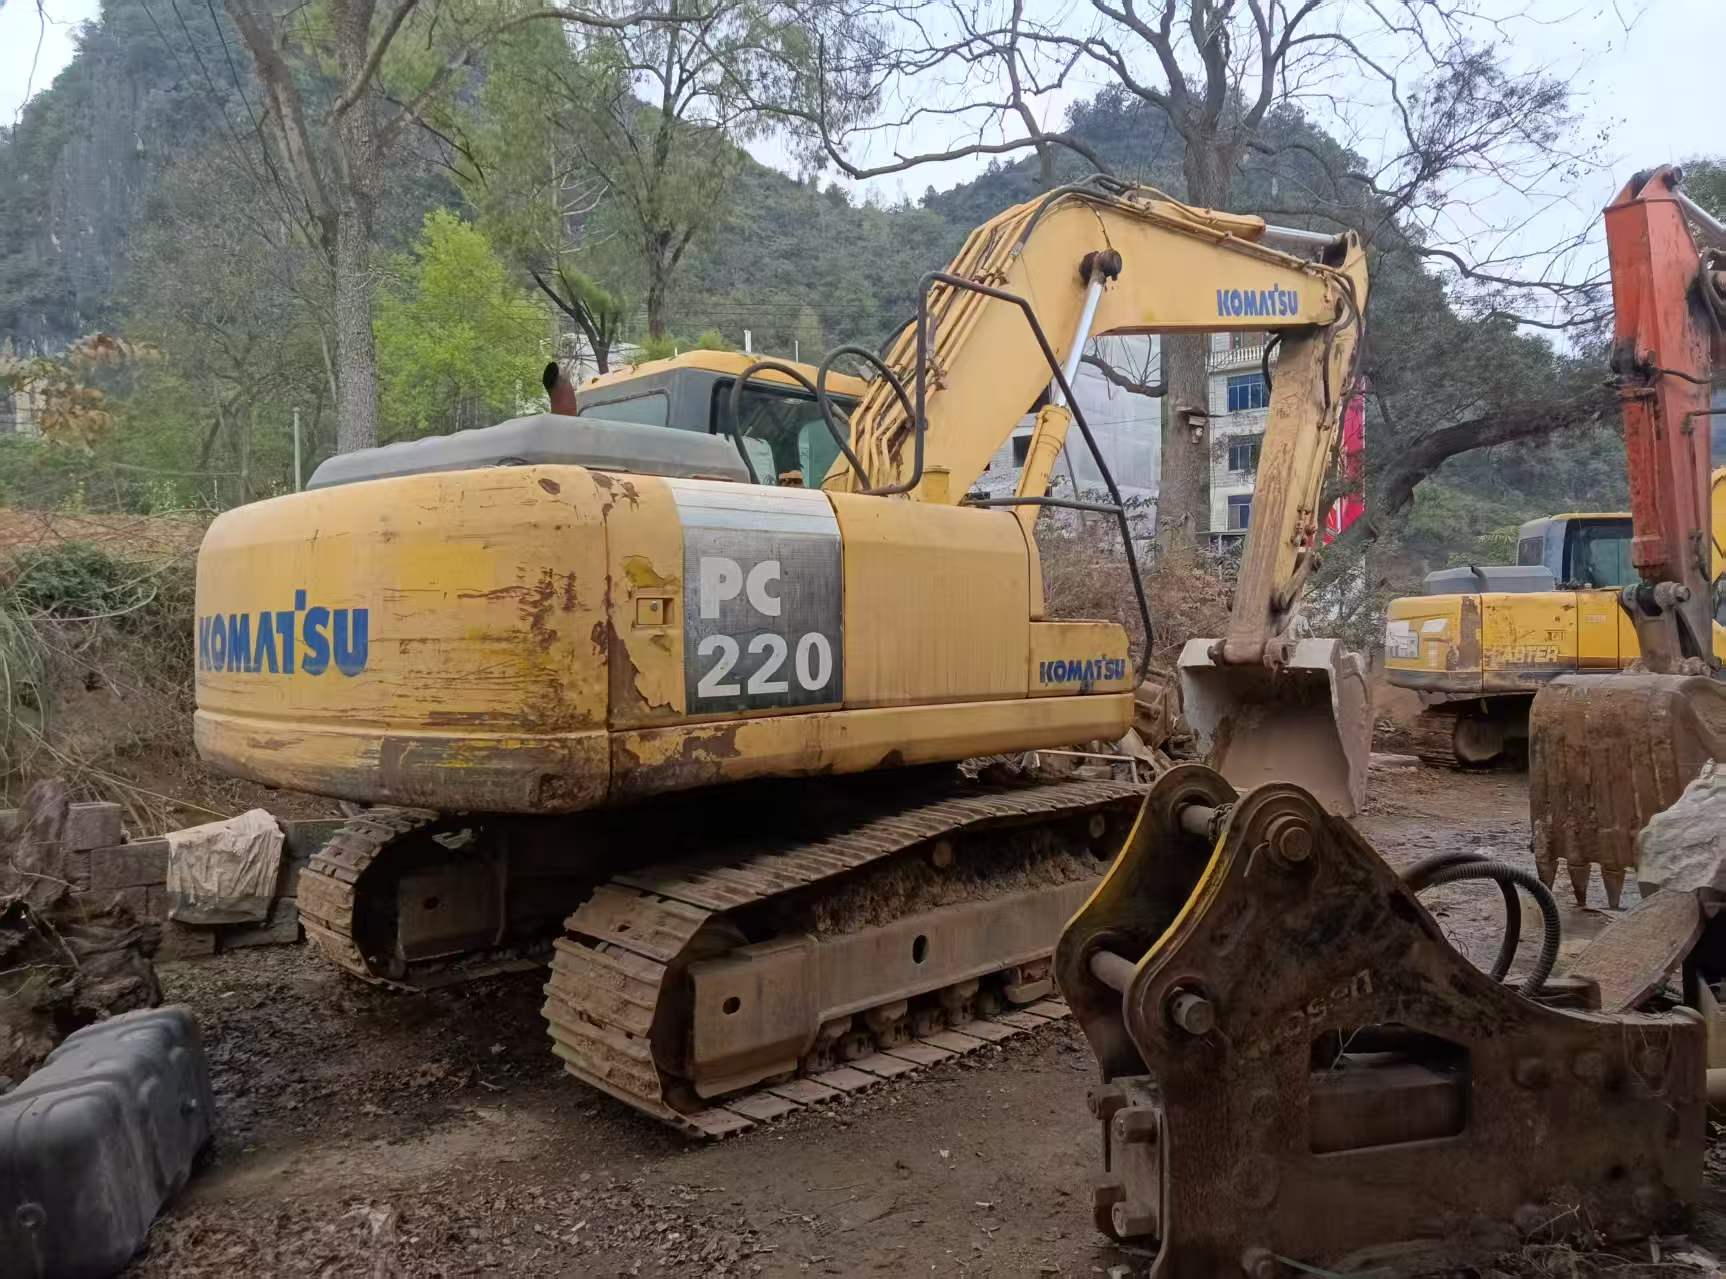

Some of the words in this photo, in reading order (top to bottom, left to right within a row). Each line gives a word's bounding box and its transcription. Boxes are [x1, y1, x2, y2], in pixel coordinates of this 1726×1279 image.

[1216, 283, 1298, 316] KOMATSU
[700, 557, 781, 618] PC
[199, 589, 368, 677] KOMATSU
[697, 632, 832, 698] 220
[1039, 654, 1126, 683] KOMATSU
